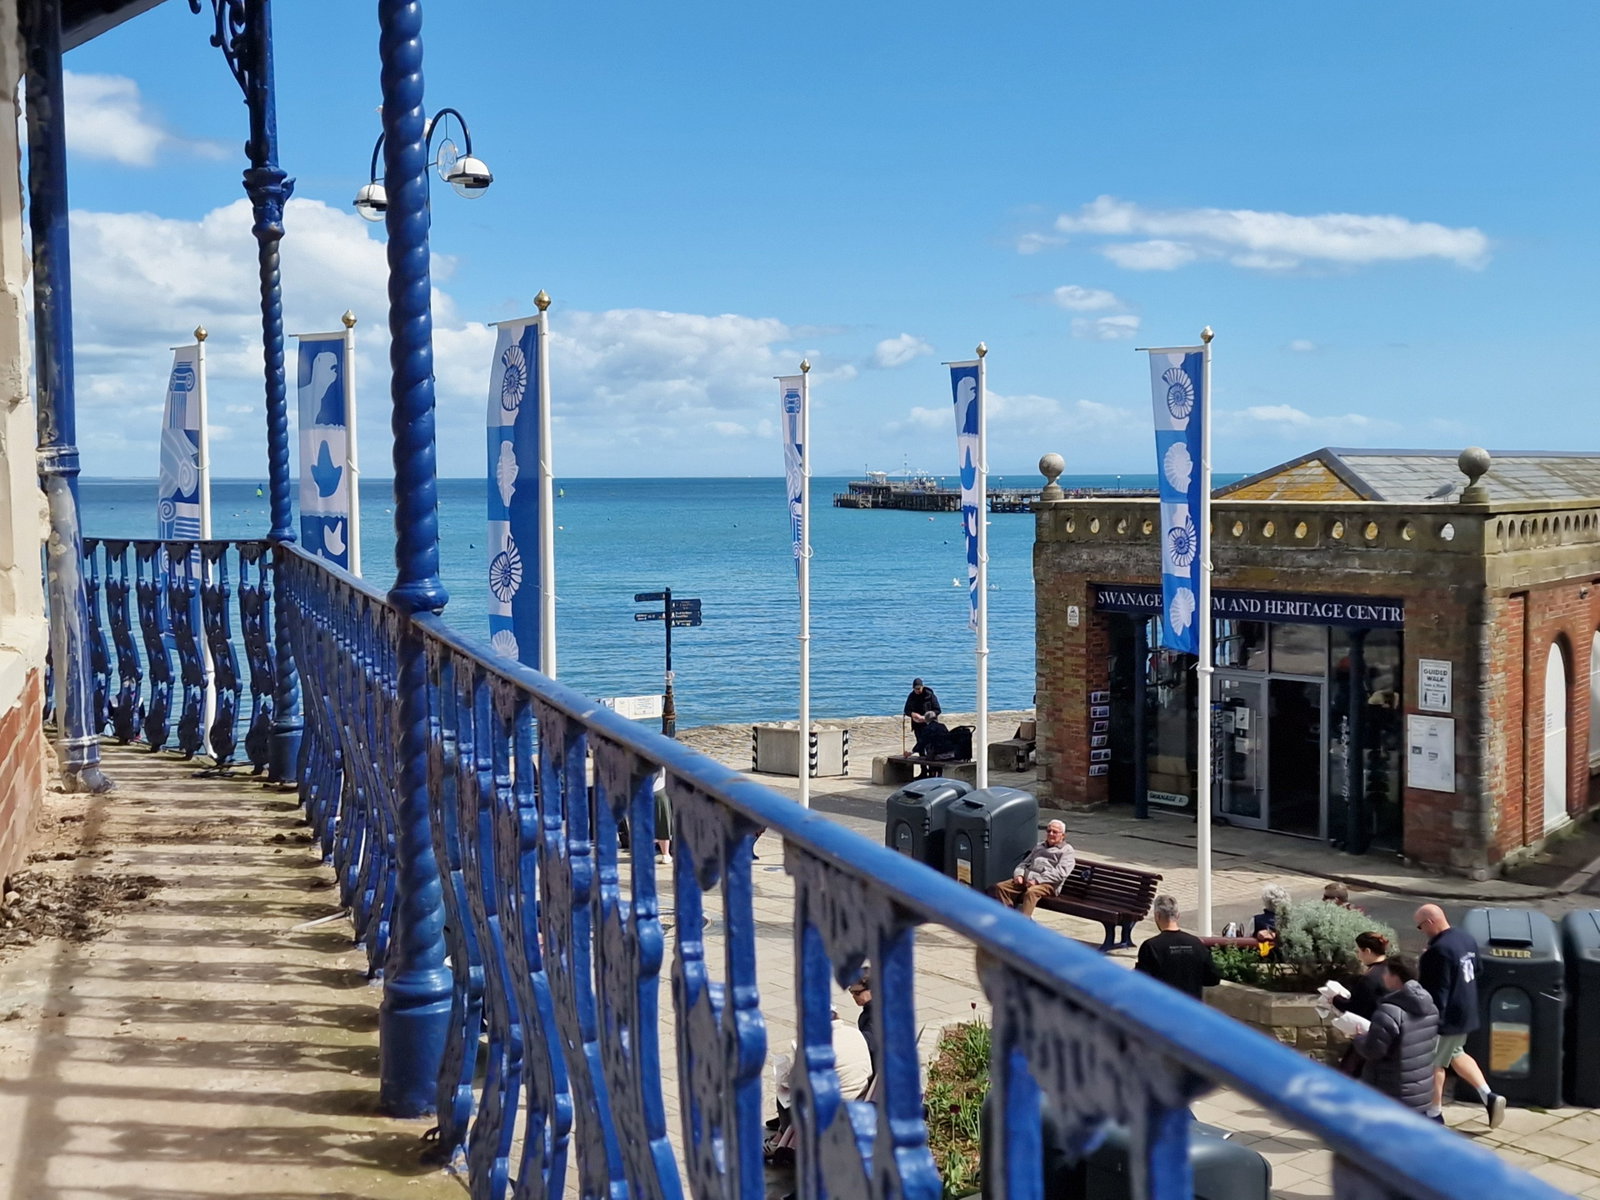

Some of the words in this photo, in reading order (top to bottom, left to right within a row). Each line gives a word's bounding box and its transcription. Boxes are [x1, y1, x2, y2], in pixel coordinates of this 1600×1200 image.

[1098, 591, 1163, 607] SWANAGE
[1228, 598, 1261, 613] AND
[1264, 600, 1344, 619] HERITAGE
[1423, 668, 1448, 677] GUIDED
[1492, 948, 1532, 959] LITTER
